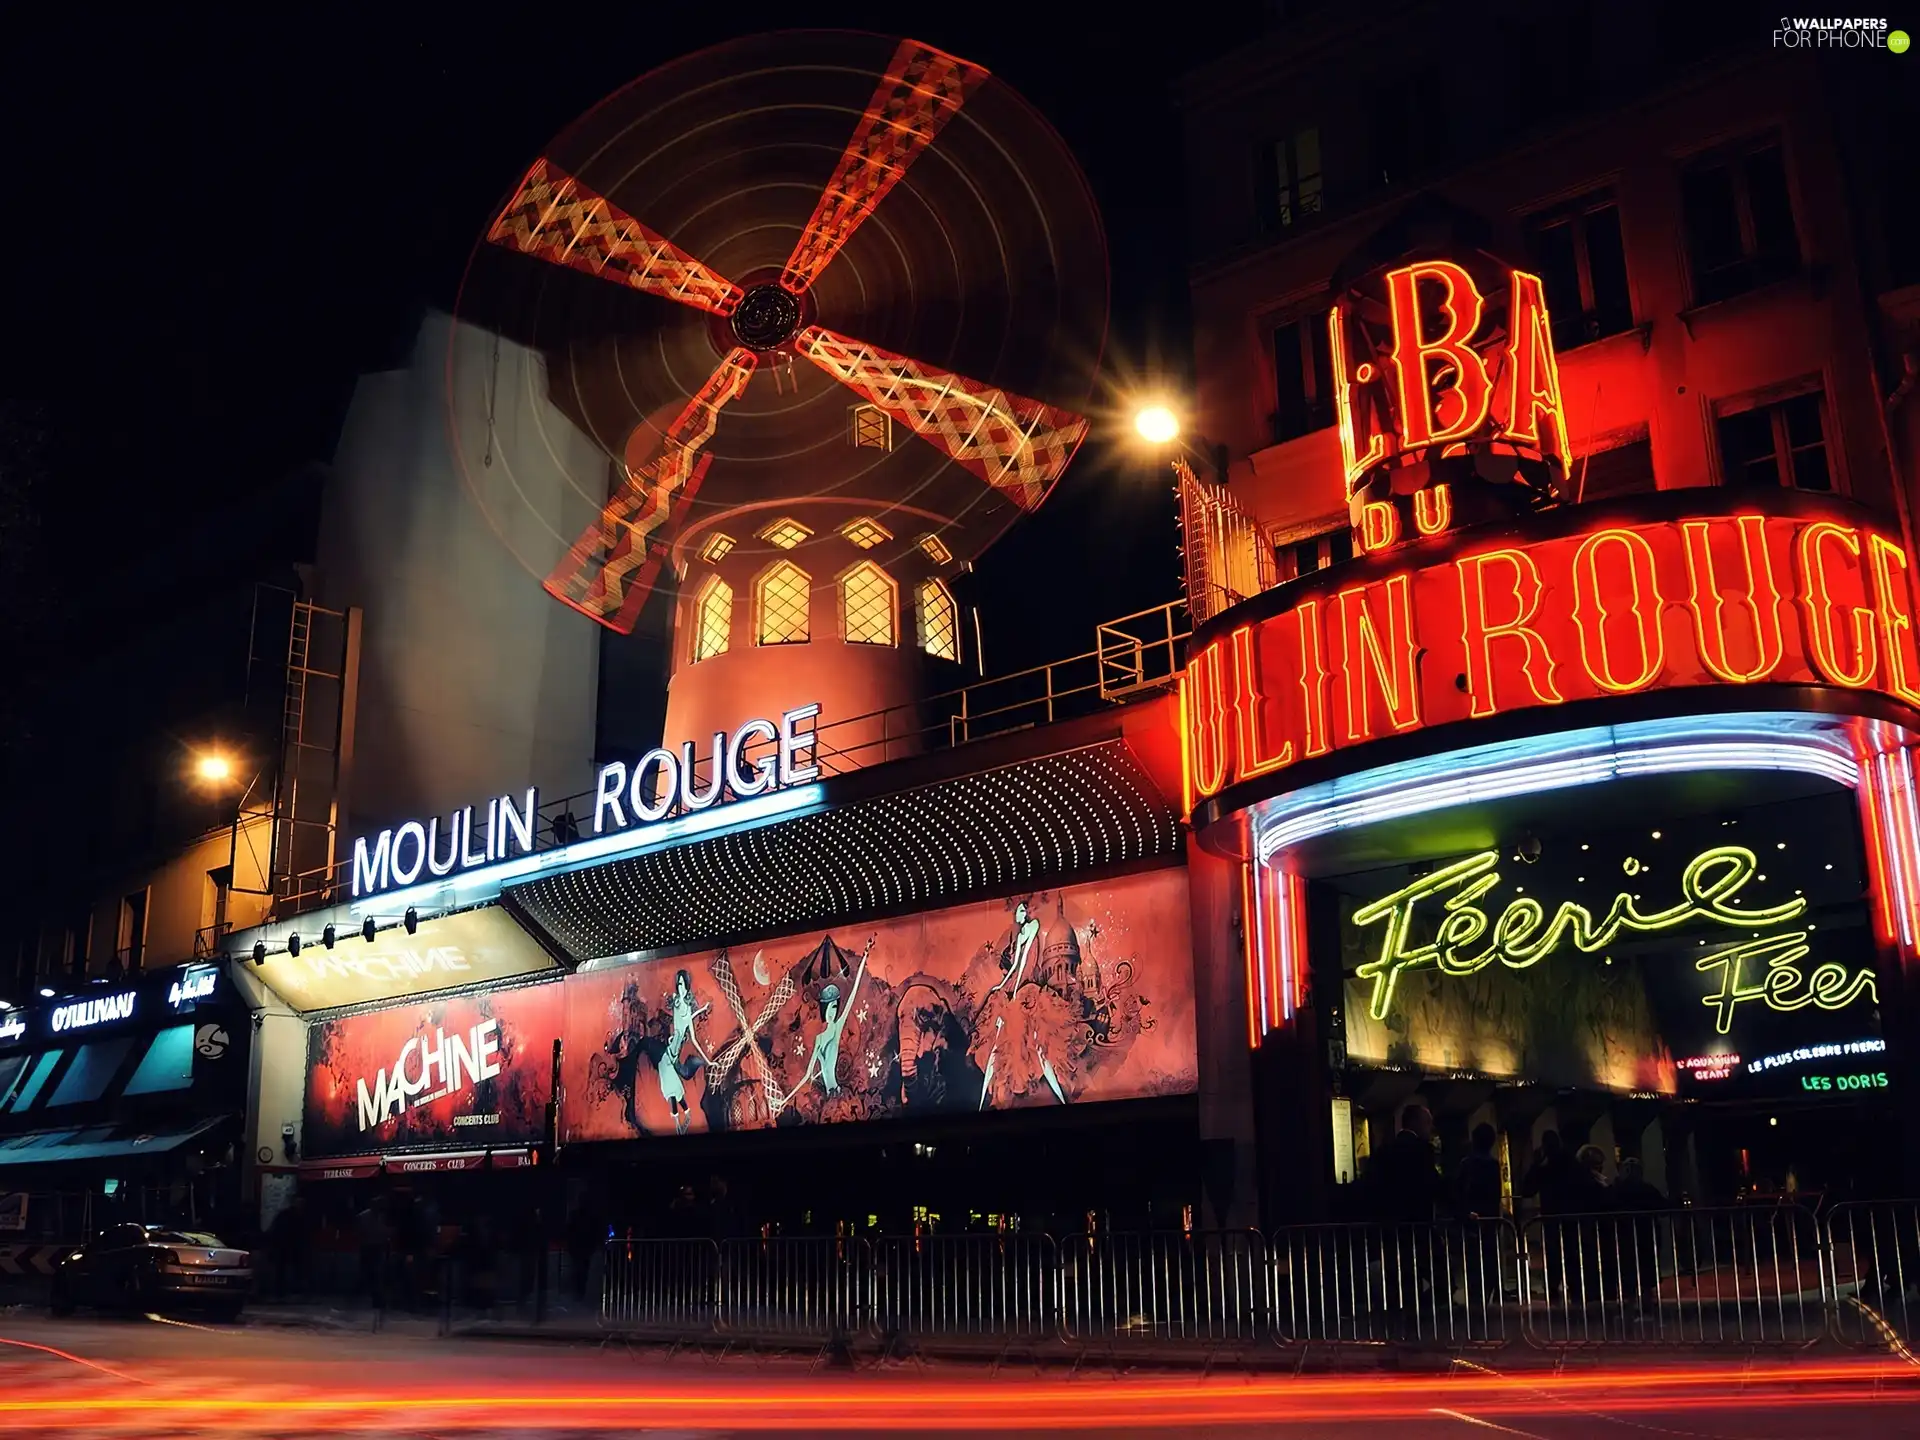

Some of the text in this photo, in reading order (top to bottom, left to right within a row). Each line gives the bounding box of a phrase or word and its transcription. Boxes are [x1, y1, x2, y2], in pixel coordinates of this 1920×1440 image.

[1361, 483, 1451, 551] DU
[1178, 515, 1920, 816] ULIN ROUGE
[351, 701, 823, 898] MOULIN ROUGE
[1351, 845, 1807, 1021] Féerie
[356, 1018, 501, 1132] MACHINE
[1748, 1060, 1762, 1073] LE
[1764, 1052, 1793, 1069] PLUS
[1801, 1072, 1889, 1091] LES DORIS
[453, 1112, 500, 1127] CONCERTS CLUB
[403, 1160, 437, 1171] CONCERTS
[446, 1158, 466, 1169] CLUB
